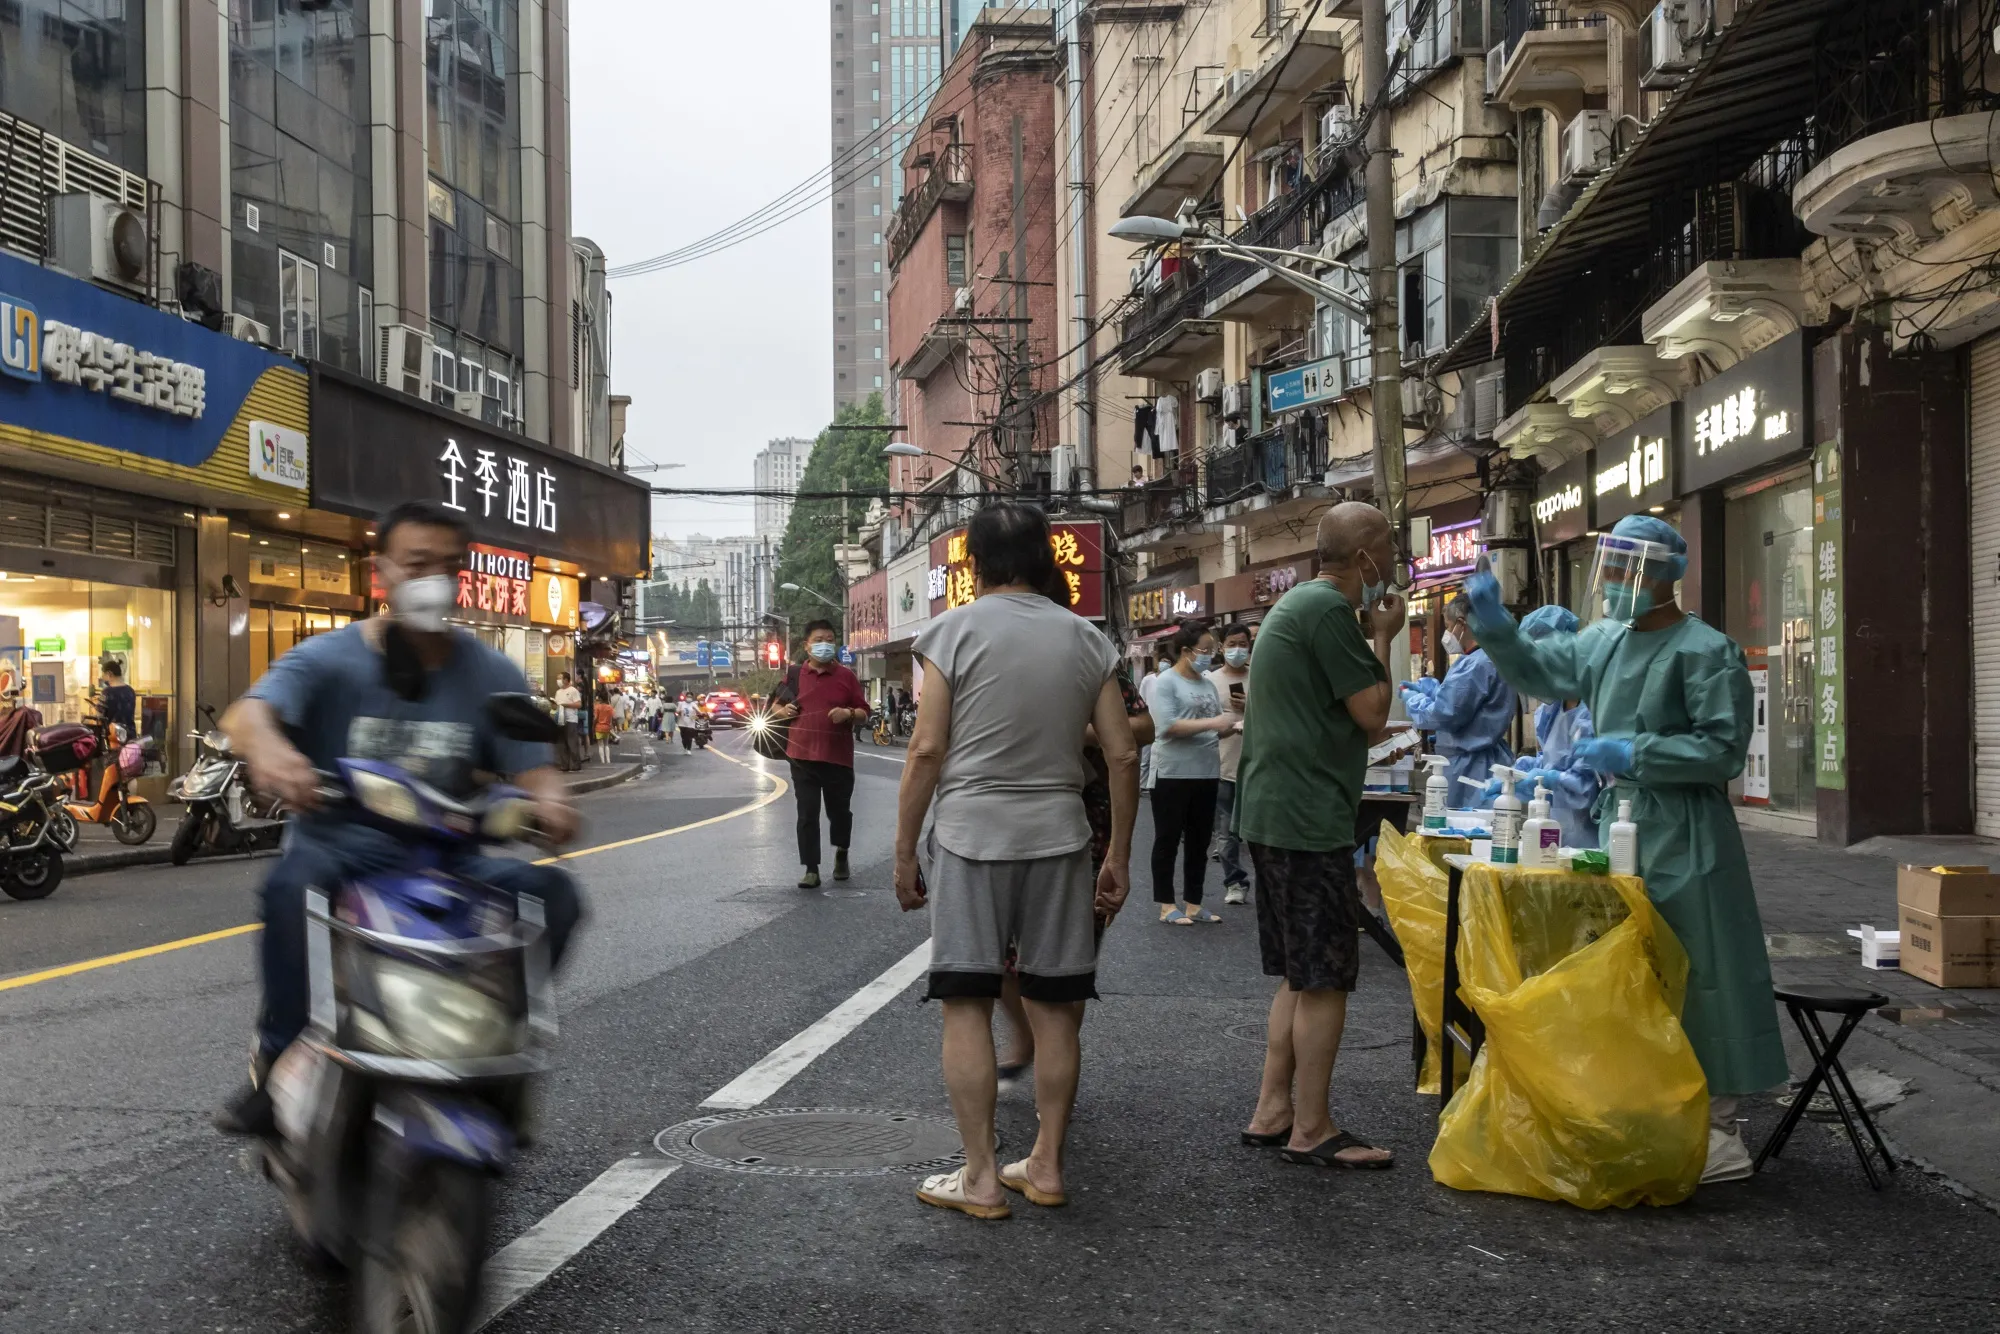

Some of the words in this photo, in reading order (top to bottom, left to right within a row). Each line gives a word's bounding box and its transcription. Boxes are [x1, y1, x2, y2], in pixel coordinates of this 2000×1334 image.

[42, 319, 206, 419] 联华生活鲜
[1694, 385, 1757, 456] 手机维修
[280, 465, 306, 483] BL.COM
[440, 438, 557, 534] 全季酒店
[486, 553, 531, 581] HOTEL
[1819, 540, 1839, 772] 维修服务点
